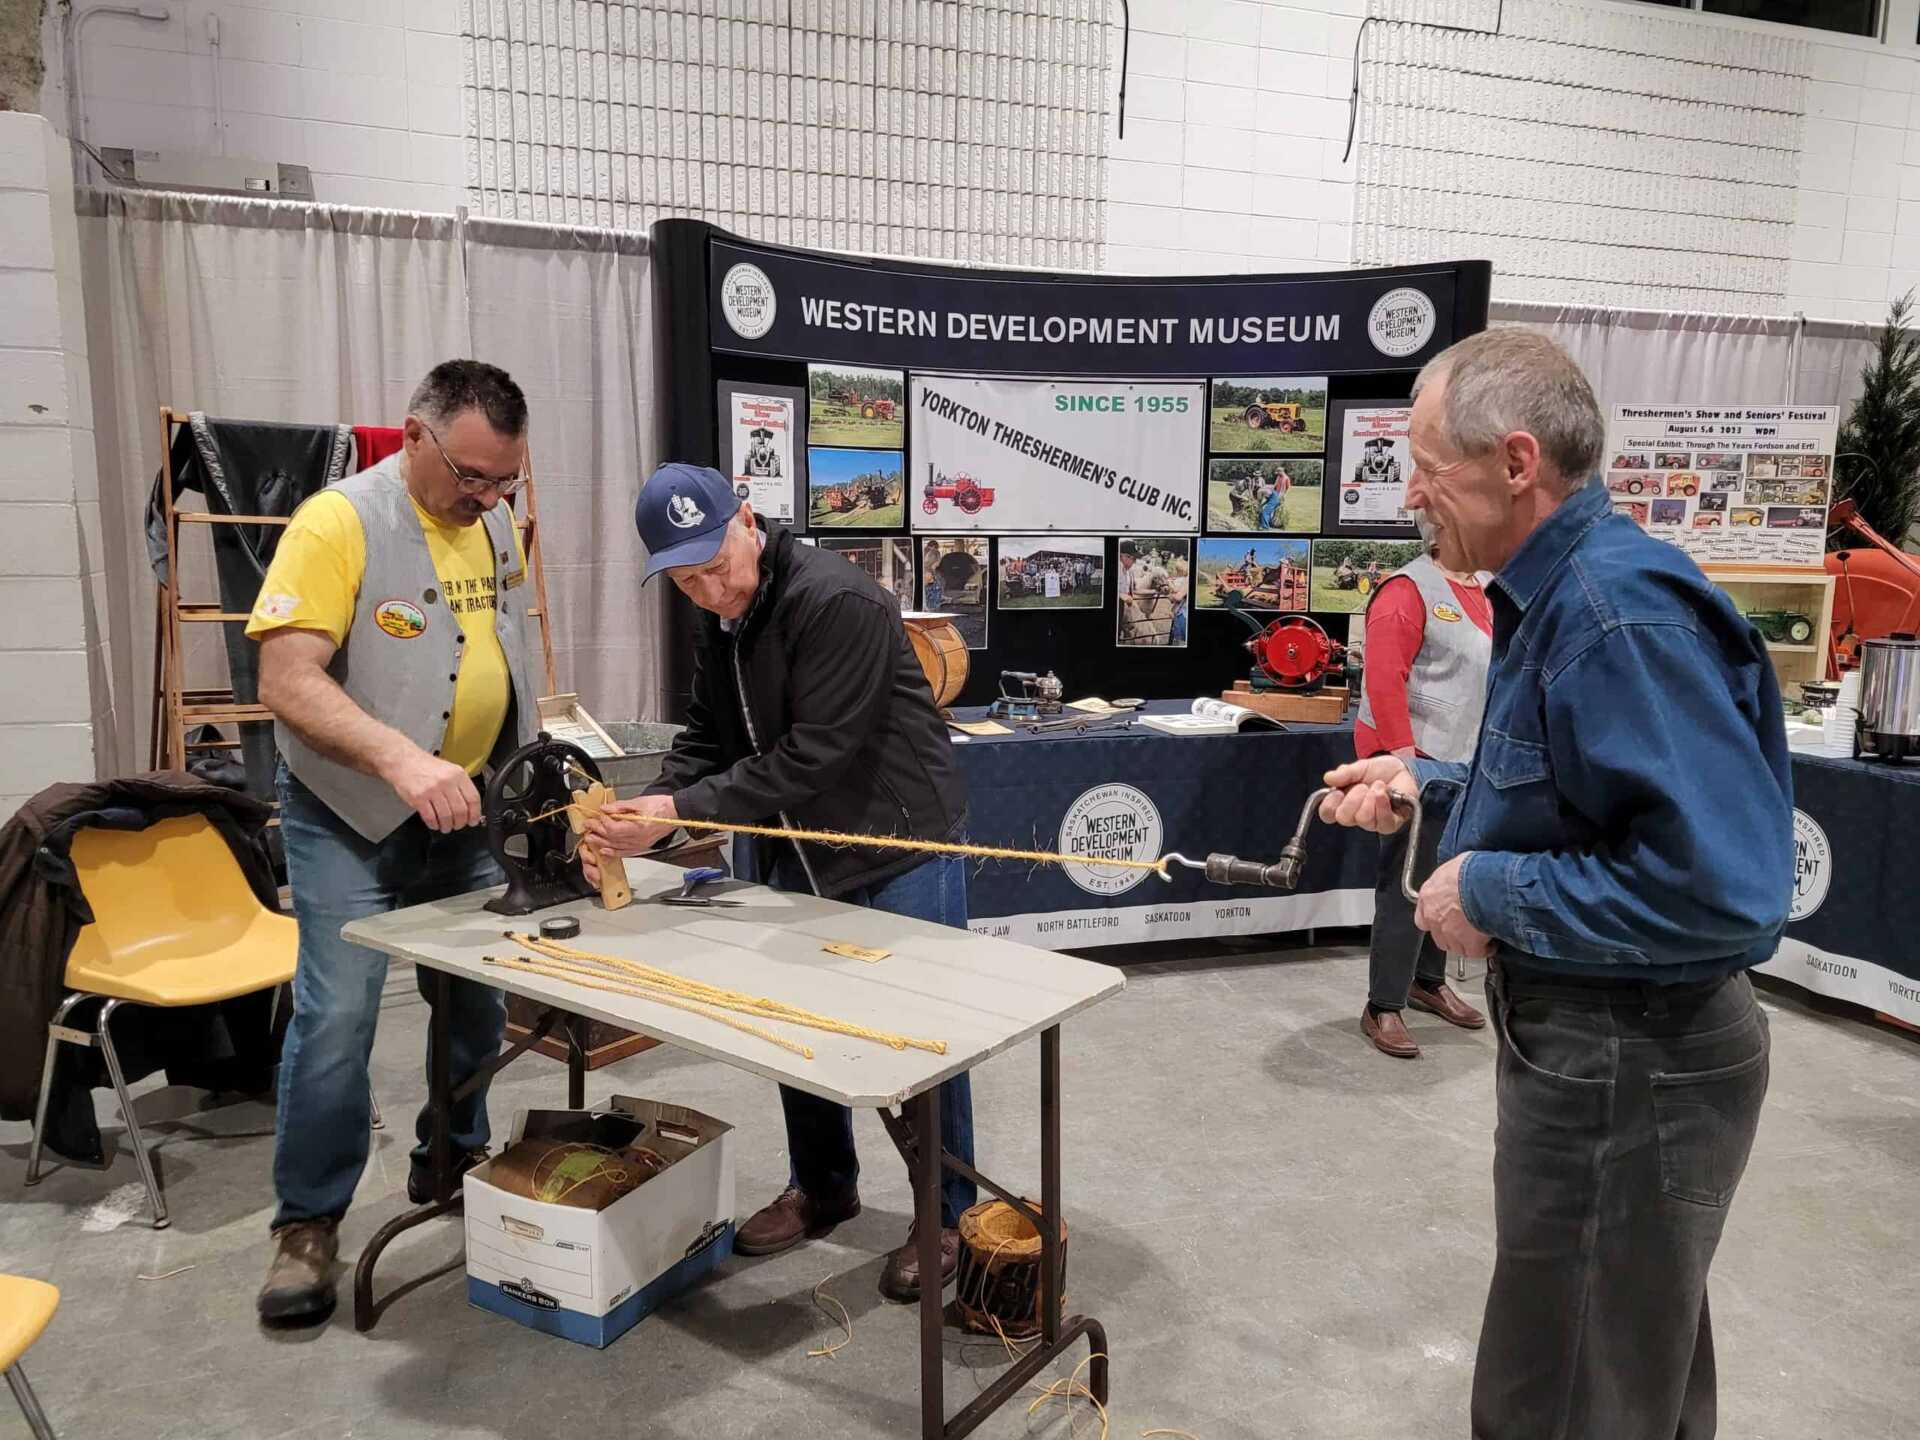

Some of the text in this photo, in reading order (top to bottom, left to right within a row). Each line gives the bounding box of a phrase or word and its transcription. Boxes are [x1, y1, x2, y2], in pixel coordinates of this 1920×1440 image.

[801, 296, 1341, 344] WESTERN DEVELOPMENT MUSEUM
[1383, 304, 1419, 319] WESTERN
[1375, 314, 1427, 332] DEVELOPMENT
[1385, 326, 1418, 340] MUSEUM
[1055, 394, 1189, 413] SINCE 1955
[1622, 408, 1827, 420] Threshermen's Show and Seniors' Festival
[1668, 425, 1697, 434] August
[1755, 427, 1776, 435] WDM
[920, 387, 1193, 521] YORKTON THRESHERMEN'S CLUB INC.
[1627, 439, 1655, 448] Special
[1686, 441, 1715, 450] Through
[465, 579, 478, 594] THE
[1066, 790, 1154, 837] SASKATCHEWAN INSPIRED
[1080, 813, 1137, 835] WESTERN
[1071, 826, 1150, 853] DEVELOPMENT
[992, 924, 1010, 937] JAW
[1037, 918, 1064, 933] NORTH
[1066, 916, 1120, 930] BATTLEFORD
[1144, 911, 1192, 925] SASKATOON
[1215, 906, 1251, 919] YORKTON
[1805, 953, 1920, 1003] SASKATOON YORKTO
